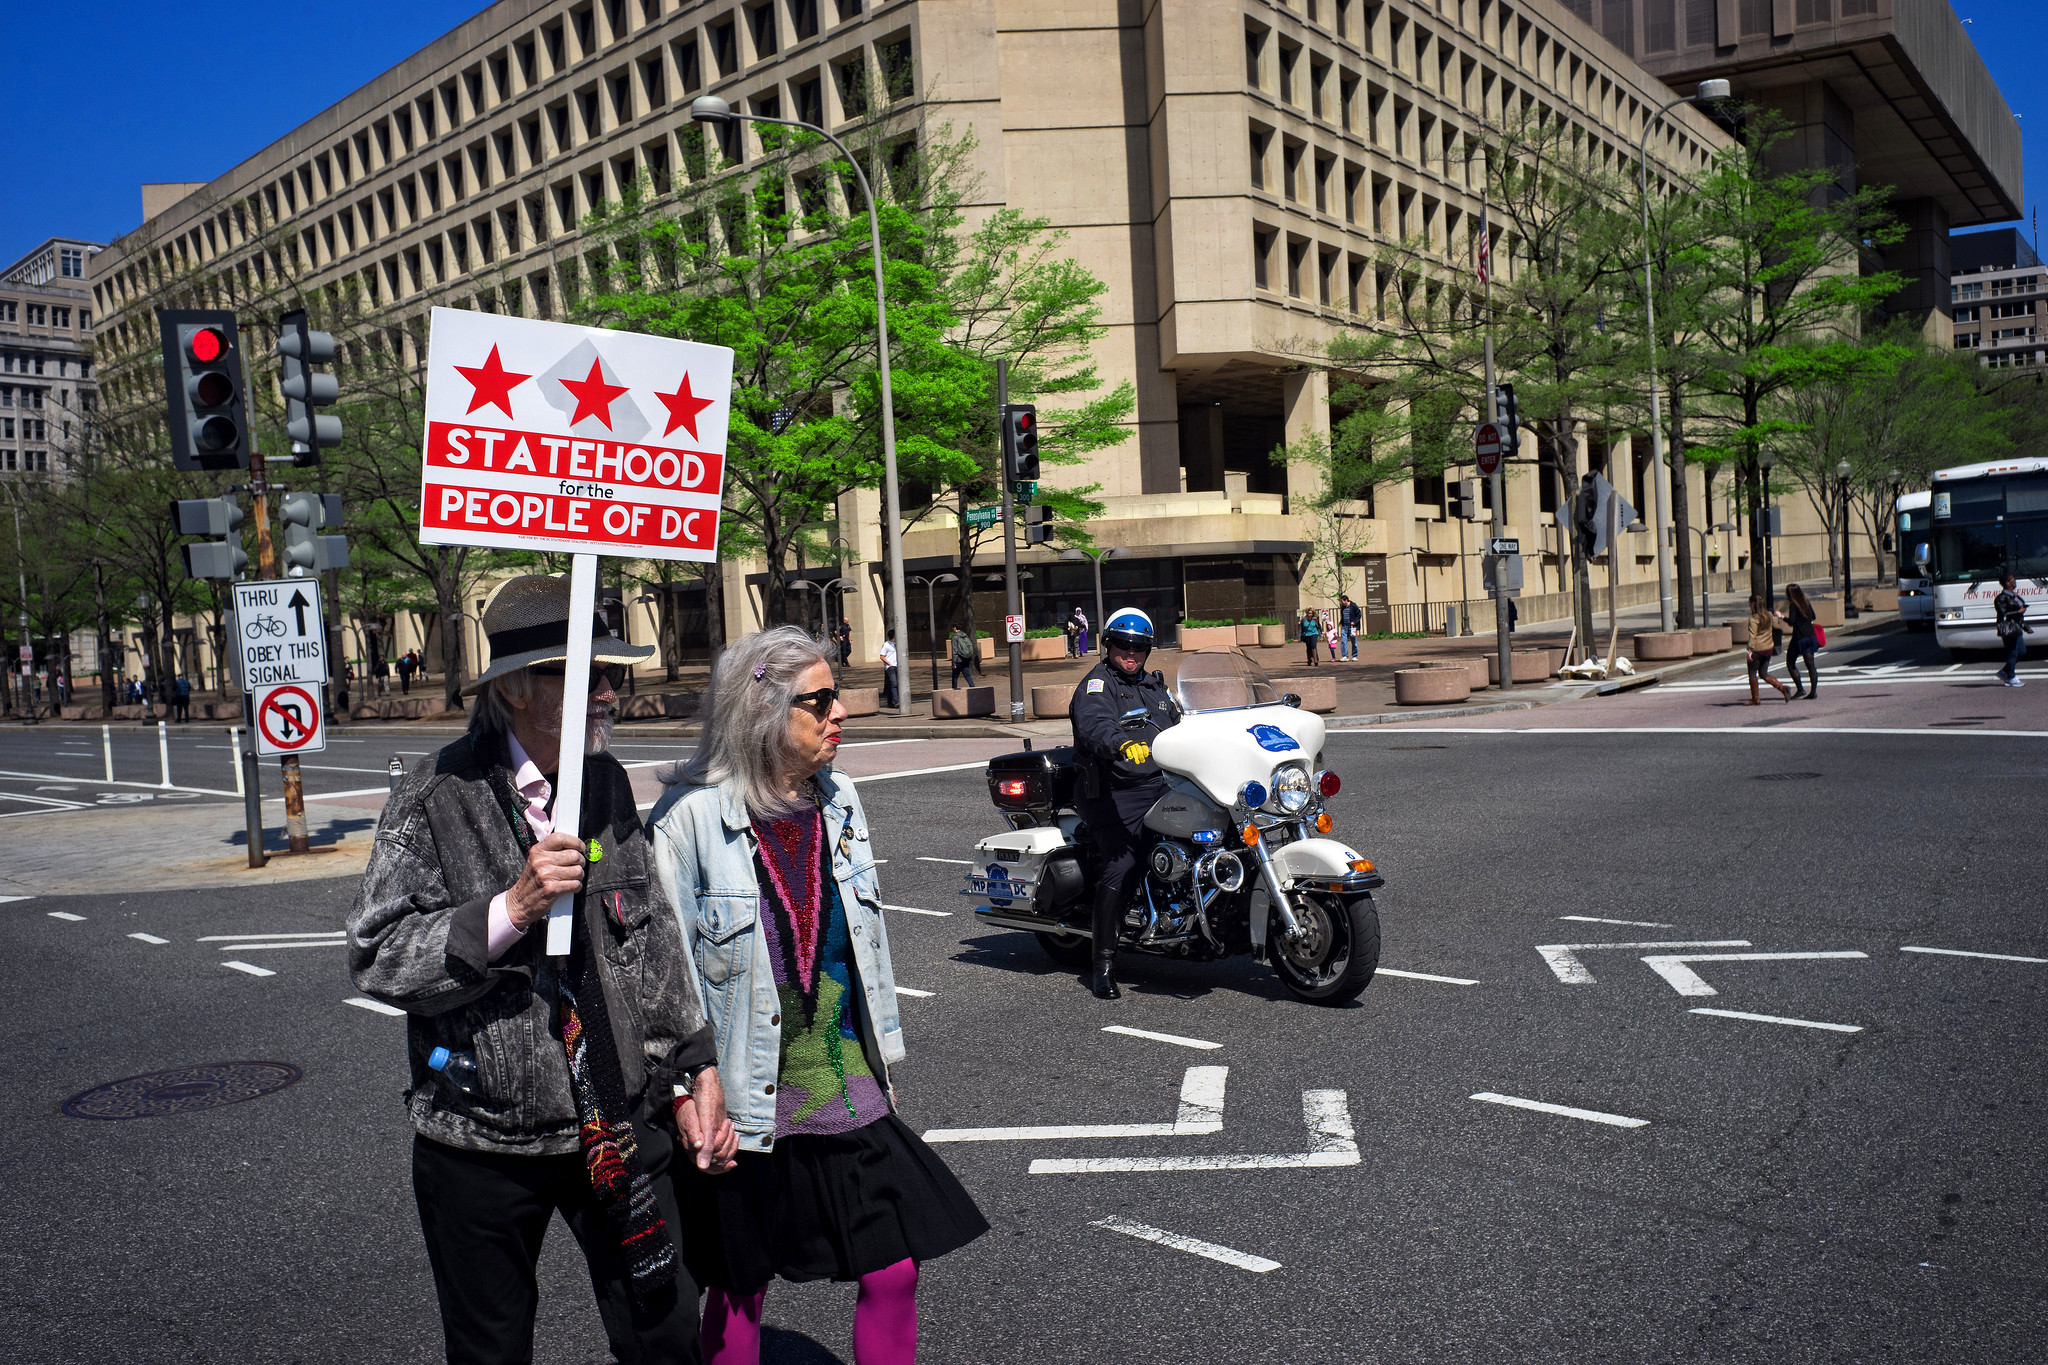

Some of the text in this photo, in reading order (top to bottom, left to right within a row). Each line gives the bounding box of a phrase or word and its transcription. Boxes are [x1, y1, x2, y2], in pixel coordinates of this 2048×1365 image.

[446, 428, 705, 488] STATEHOOD
[559, 480, 614, 499] for the
[1016, 482, 1022, 493] 9
[440, 488, 701, 542] PEOPLE OF DC
[966, 510, 991, 522] Pennsylvania
[980, 521, 991, 529] 900
[240, 588, 278, 607] THRU
[1963, 591, 1979, 600] FUN
[2015, 587, 2043, 596] ERVICE
[247, 641, 320, 664] OBEY THIS
[249, 664, 301, 684] SIGNAL
[998, 852, 1018, 860] POLICE
[972, 880, 1027, 896] MP DC
